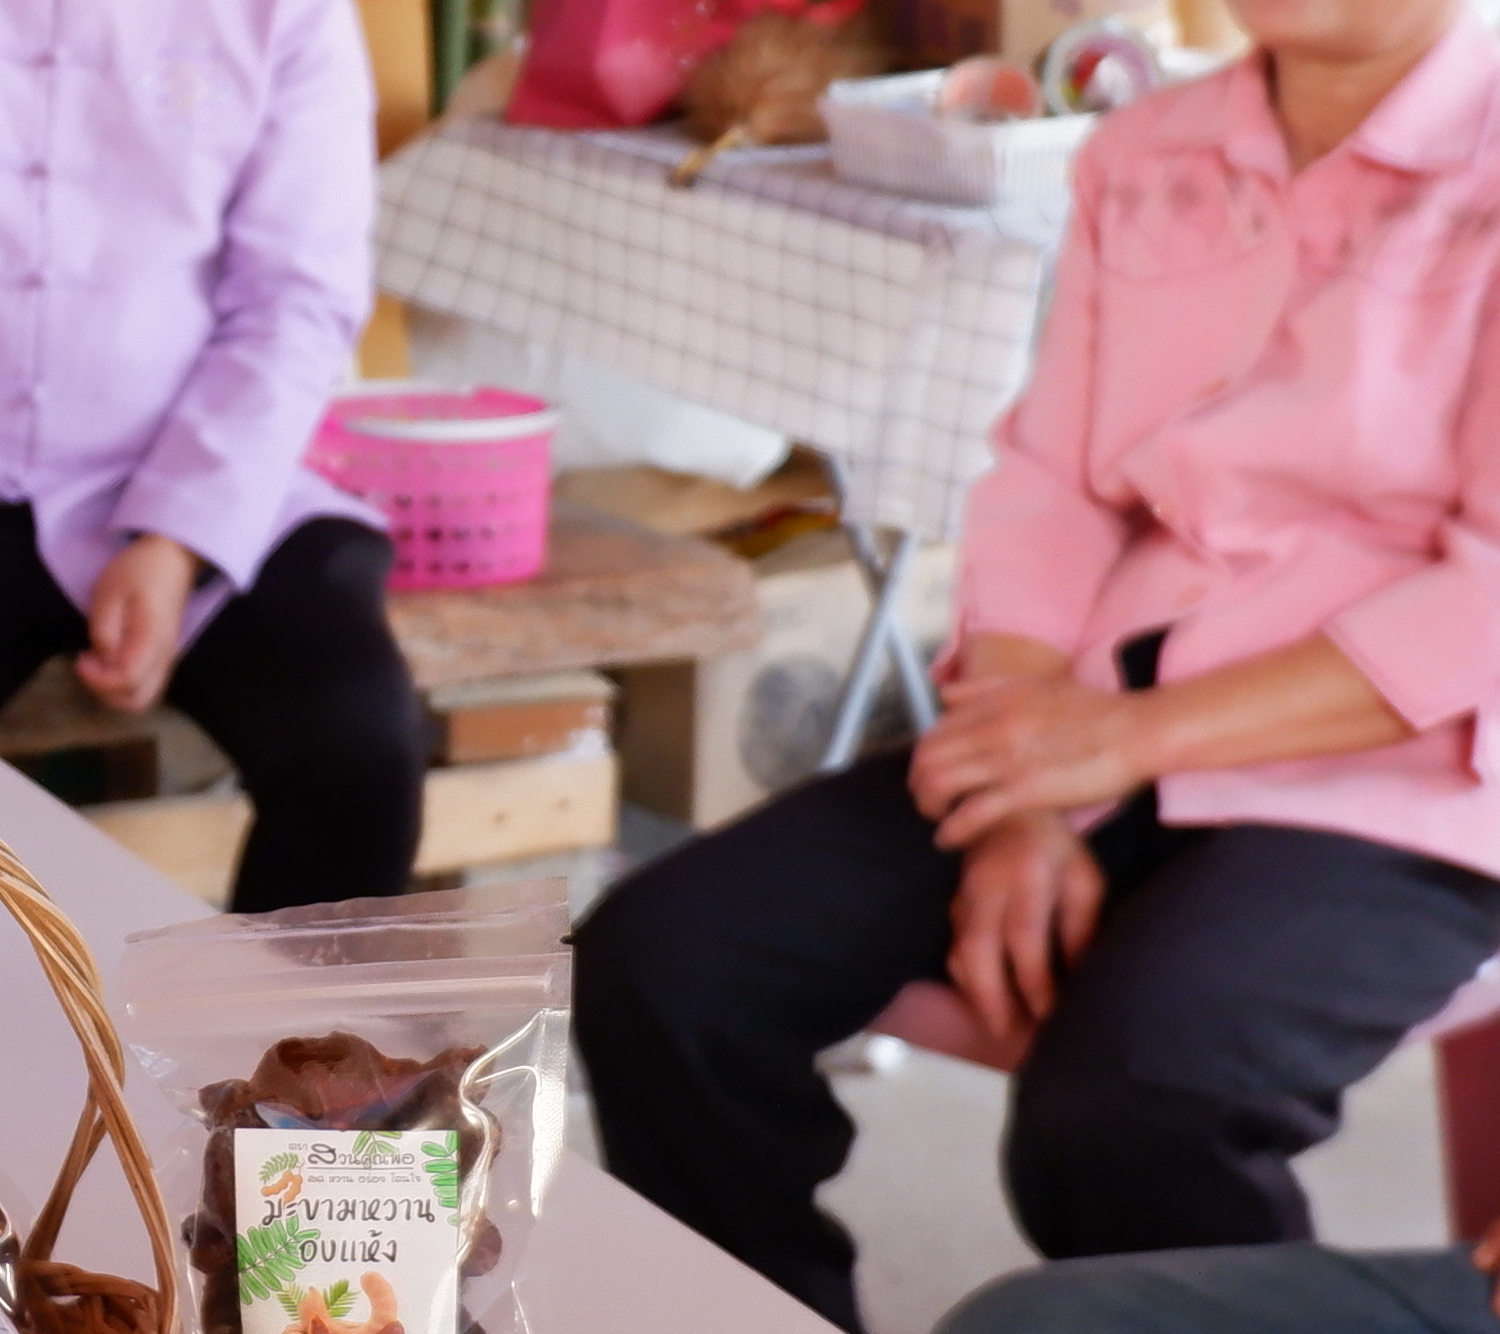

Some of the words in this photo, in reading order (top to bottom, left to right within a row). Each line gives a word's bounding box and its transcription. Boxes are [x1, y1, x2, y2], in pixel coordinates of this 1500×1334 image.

[261, 1197, 436, 1227] มะขามหวาน
[299, 1229, 398, 1263] อบแห้ง
